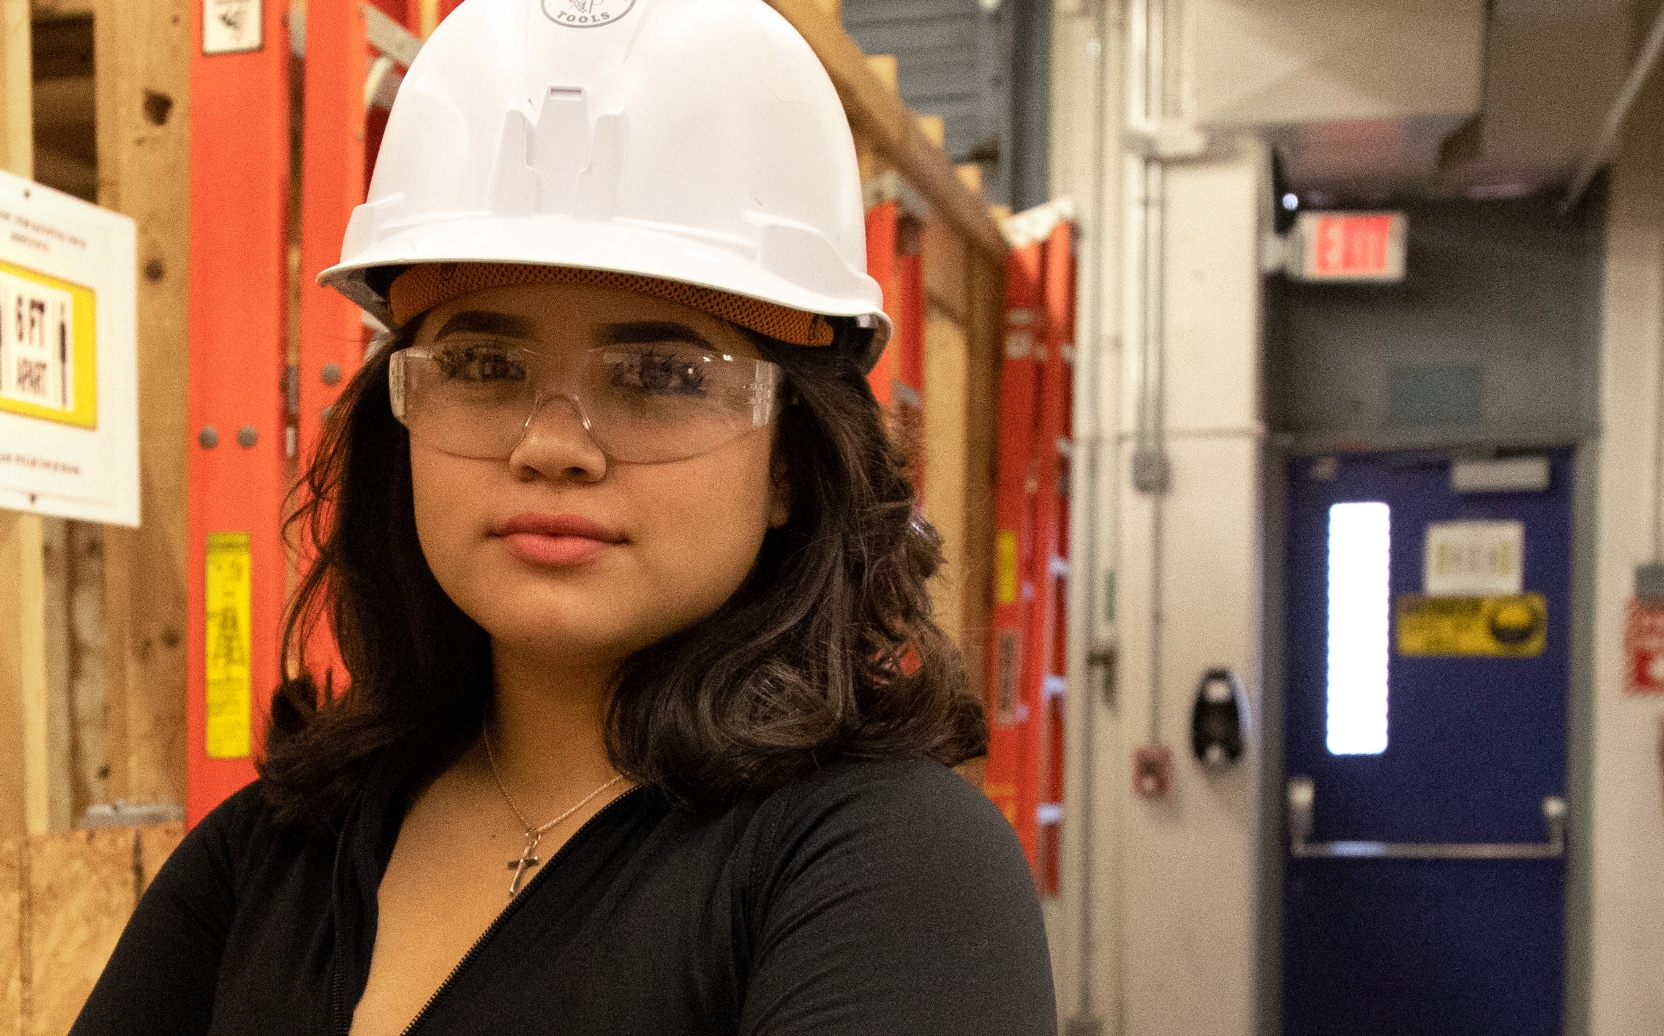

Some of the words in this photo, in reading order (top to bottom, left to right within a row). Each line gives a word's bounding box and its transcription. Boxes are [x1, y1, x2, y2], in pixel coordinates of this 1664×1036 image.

[557, 10, 611, 24] TOOLS
[15, 293, 25, 342] 6
[28, 297, 46, 347] FT
[16, 357, 48, 396] APART
